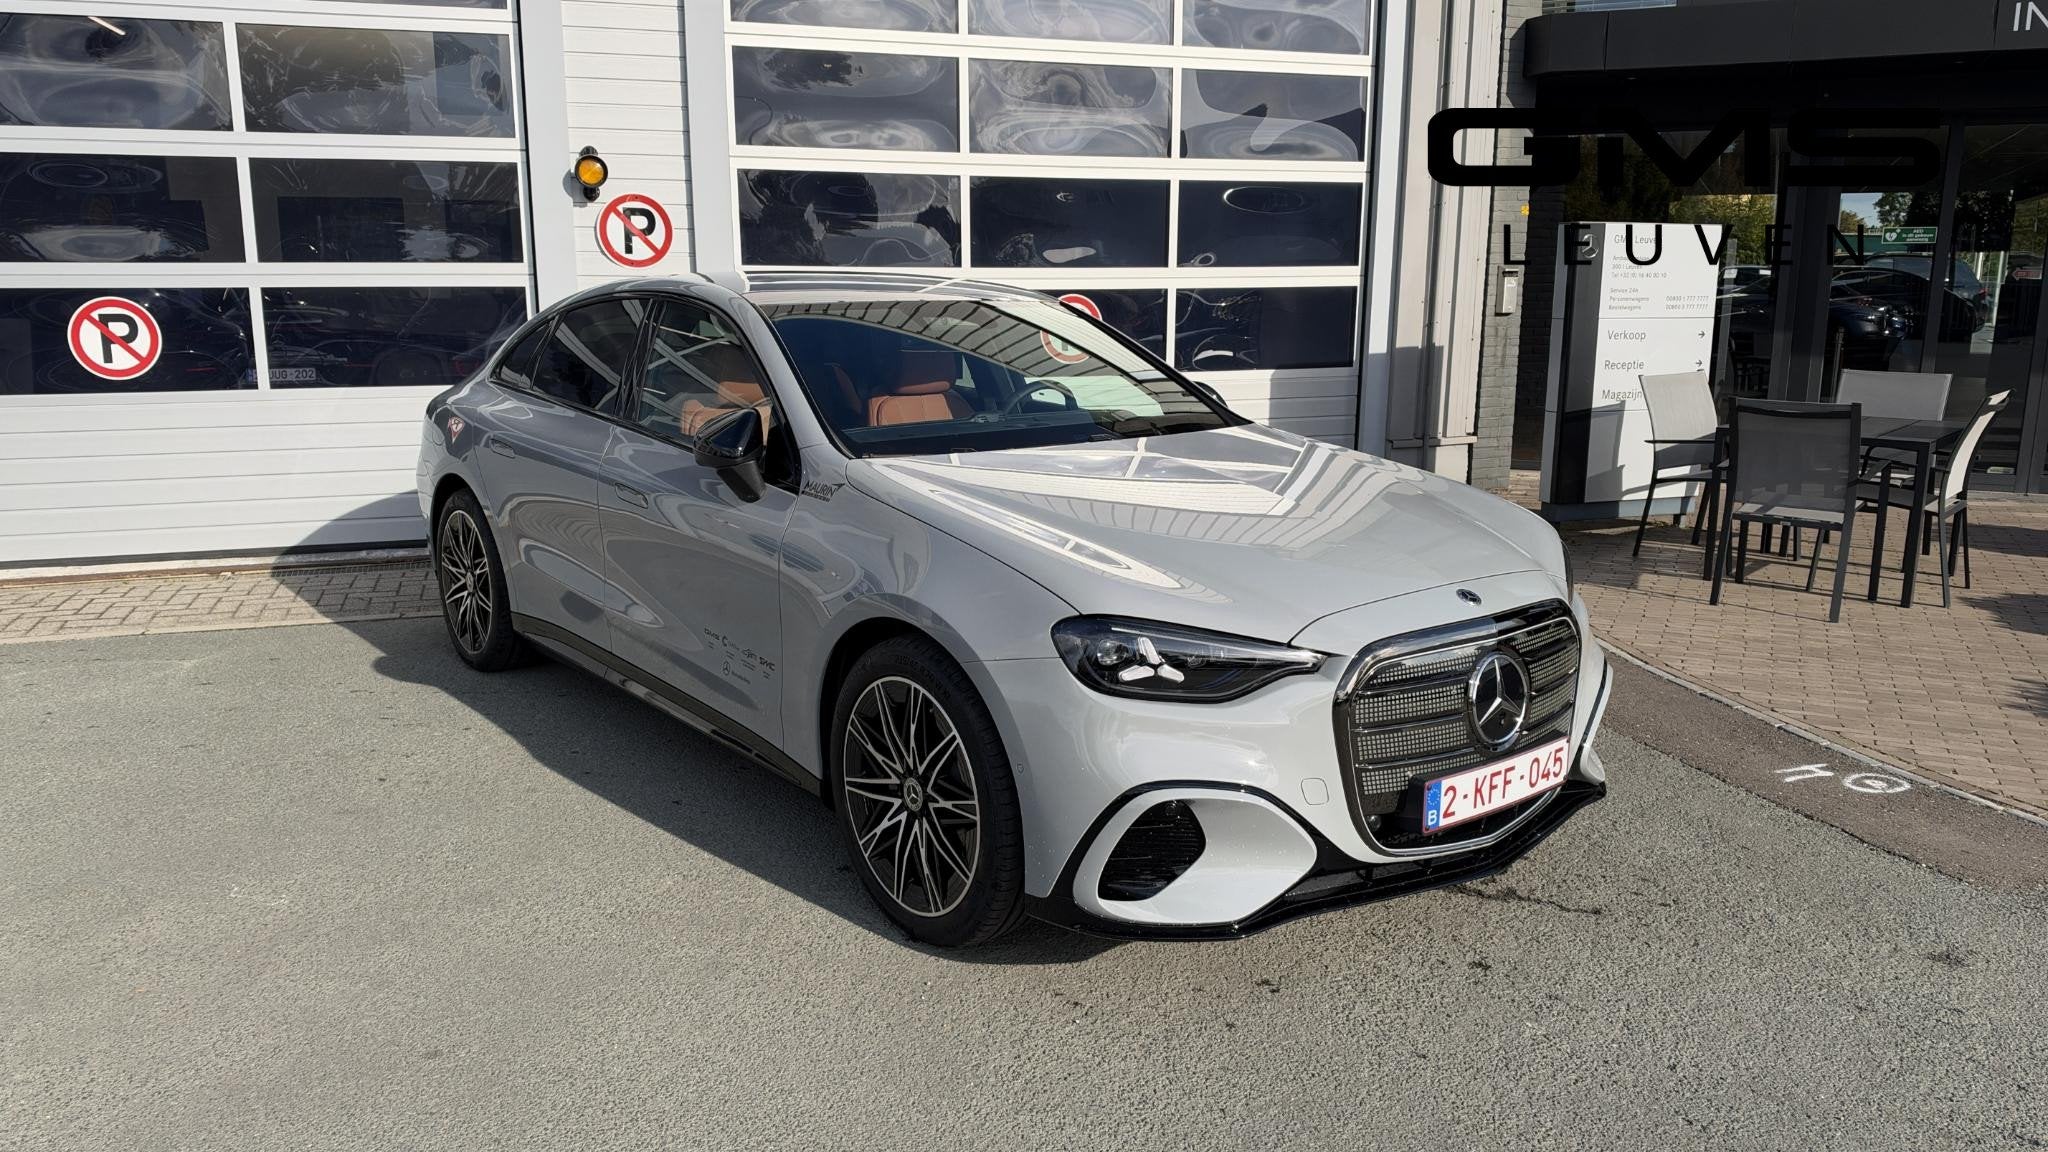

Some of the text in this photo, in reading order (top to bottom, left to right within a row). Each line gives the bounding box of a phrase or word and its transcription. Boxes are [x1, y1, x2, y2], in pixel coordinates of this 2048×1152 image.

[2013, 1, 2048, 31] IN
[1607, 330, 1646, 342] Verkoop
[1604, 359, 1645, 372] Receptie
[1602, 389, 1643, 402] Magazijn
[1427, 747, 1564, 826] B 2-KFF-045
